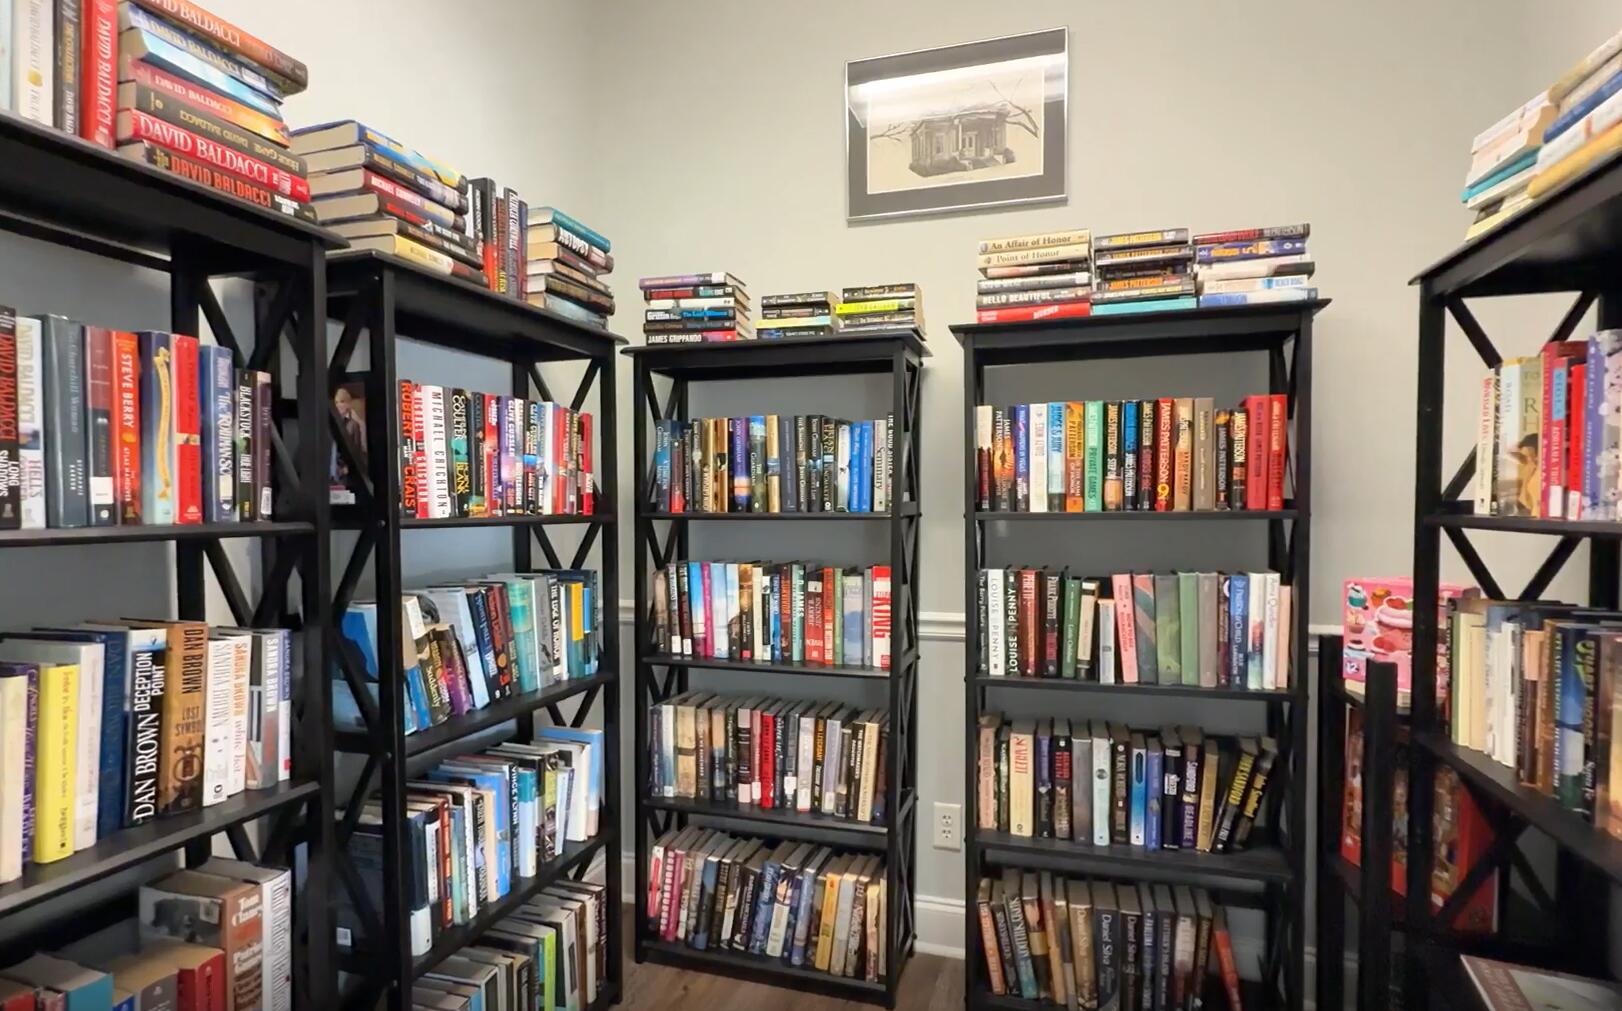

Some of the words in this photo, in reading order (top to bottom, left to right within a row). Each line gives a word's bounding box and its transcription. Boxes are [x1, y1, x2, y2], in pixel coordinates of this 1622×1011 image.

[180, 4, 241, 47] BALDACCI
[98, 19, 112, 75] DAVID
[154, 76, 186, 96] DAVID
[97, 77, 112, 135] BALDACCI
[139, 115, 192, 152] DAVID
[195, 142, 269, 184] BALDACCI
[170, 157, 212, 186] DAVID
[213, 174, 271, 208] BALDACCI
[992, 243, 1003, 251] An
[1005, 239, 1029, 250] Affair
[1031, 237, 1041, 247] of
[1043, 234, 1072, 246] Honor
[1021, 252, 1031, 261] of
[982, 294, 1007, 305] HELLO
[1009, 292, 1052, 303] BEAUTIFUL
[0, 333, 15, 372] DAVID
[648, 335, 668, 344] JAMES
[669, 333, 702, 343] GRIPPANDO
[122, 353, 134, 388] STEVE
[0, 375, 17, 441] BALDACCI
[122, 391, 135, 428] BERRY
[218, 391, 233, 414] The
[240, 385, 252, 439] BLACKSTOCK
[401, 382, 415, 439] ROBERT
[431, 391, 444, 442] MICHAEL
[453, 395, 465, 441] COULTER
[508, 400, 516, 423] CLIVE
[530, 404, 538, 424] CLIVE
[1107, 404, 1118, 423] JAMES
[1159, 402, 1172, 430] JAMES
[735, 420, 743, 438] JOHN
[995, 410, 1004, 448] PATTERSON
[1003, 419, 1011, 439] JAMES
[1217, 426, 1227, 450] JAMES
[1233, 411, 1247, 432] JAMES
[124, 446, 132, 465] ATLAS
[508, 423, 516, 457] CUSSLER
[1051, 436, 1063, 453] JURY
[1068, 420, 1078, 458] PATTERSON
[1233, 432, 1247, 464] PATTERSON
[0, 449, 10, 498] SHADOWS
[8, 460, 20, 487] LONG
[1088, 447, 1098, 474] PRIVATE
[1158, 431, 1172, 484] PATTERSON
[1217, 450, 1227, 491] PATTERSON
[404, 466, 417, 507] CRAIS
[433, 449, 448, 508] CRICHTON
[456, 461, 466, 495] BLANK
[1088, 475, 1097, 499] GAMES
[990, 577, 1000, 614] LOUISE
[1047, 576, 1058, 595] FRANK
[796, 591, 804, 618] JAMES
[872, 596, 891, 639] KING
[1008, 587, 1017, 622] PENNY
[182, 628, 204, 652] DAN
[991, 624, 1000, 660] PENNY
[1008, 635, 1018, 672] LOUISE
[181, 654, 203, 695] BROWN
[234, 642, 248, 679] SANDRA
[266, 638, 279, 677] SANDRA
[134, 650, 153, 712] DECEPTION
[151, 663, 166, 697] POINT
[266, 679, 278, 713] BROWN
[426, 665, 441, 708] Suddenly
[233, 682, 247, 716] BROWN
[135, 712, 160, 777] BROWN
[234, 719, 246, 750] white
[234, 753, 246, 773] hot
[1184, 760, 1198, 793] SANDFORD
[511, 764, 519, 797] VINCE
[132, 778, 157, 823] DAN
[1183, 804, 1196, 841] DEADLINE
[1101, 913, 1113, 944] Daniel
[1126, 915, 1137, 943] Daniel
[1102, 943, 1113, 966] Silva
[1127, 943, 1137, 963] Silva
